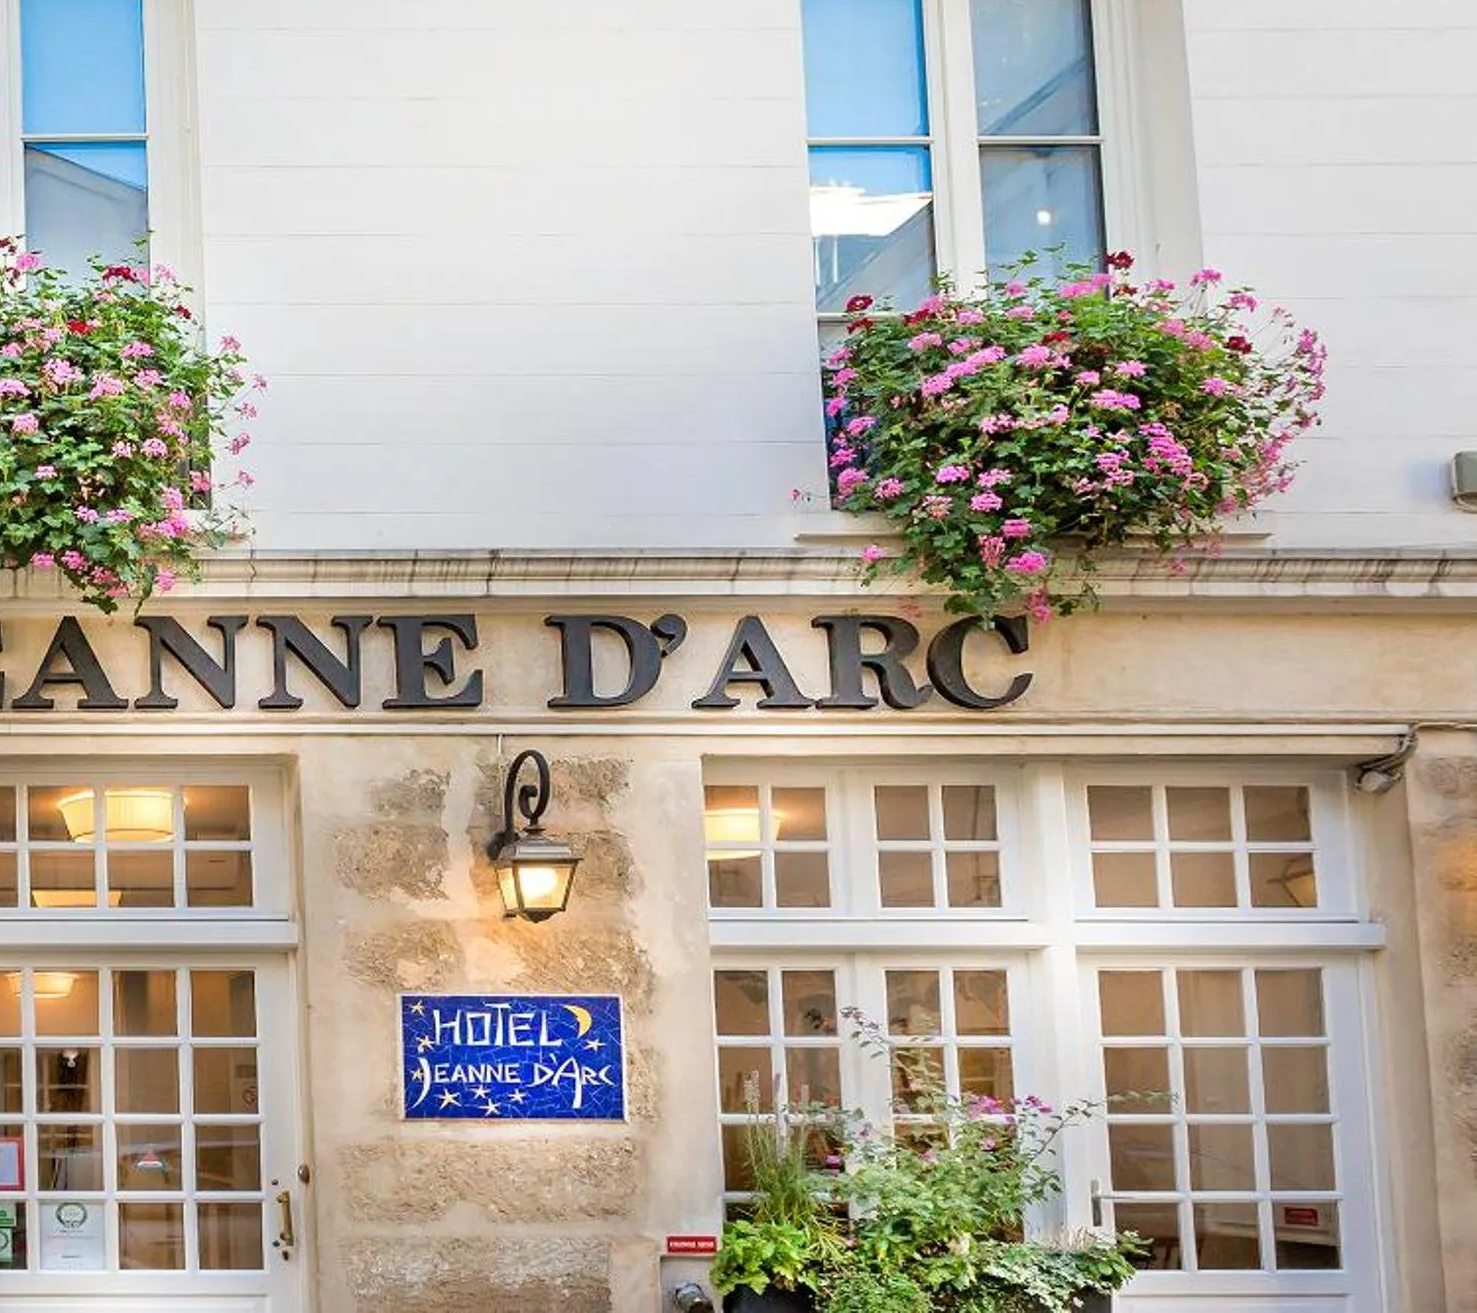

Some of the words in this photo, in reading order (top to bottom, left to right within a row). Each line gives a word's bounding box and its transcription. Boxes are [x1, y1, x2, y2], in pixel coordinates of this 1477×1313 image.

[542, 613, 1034, 711] D'ARC
[432, 1001, 563, 1047] HOTEL
[411, 1054, 522, 1109] JEANNE
[526, 1053, 617, 1109] D'ARC
